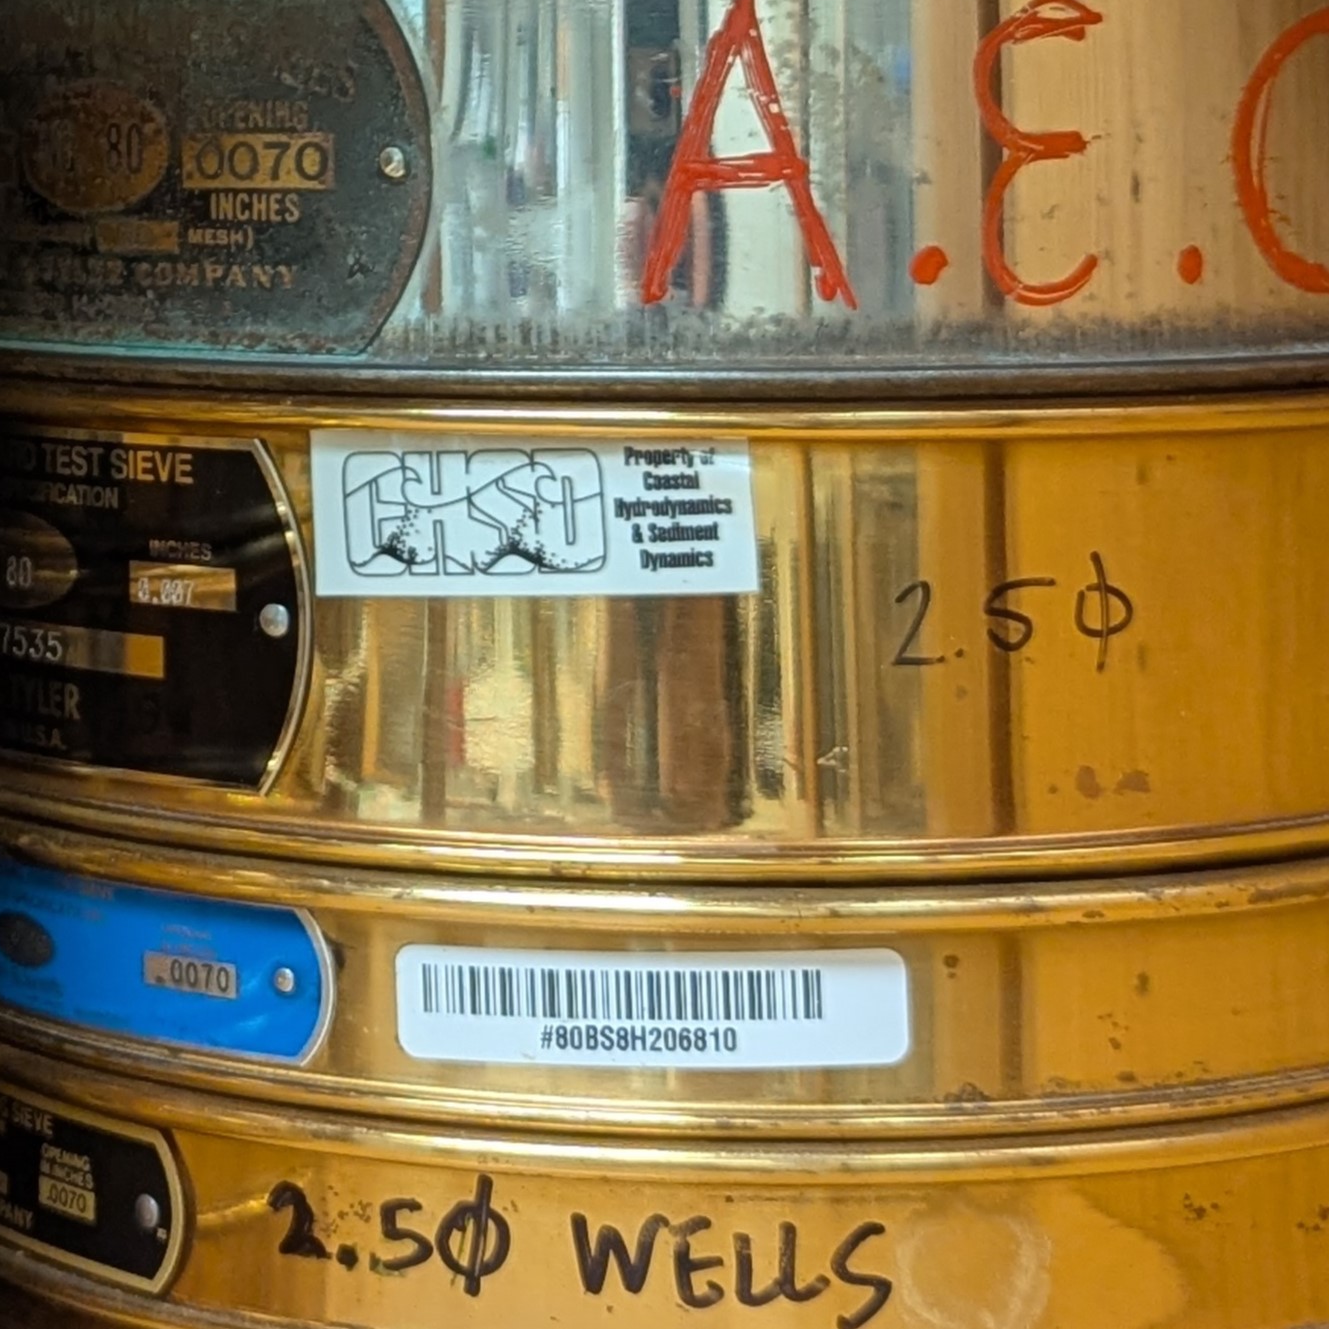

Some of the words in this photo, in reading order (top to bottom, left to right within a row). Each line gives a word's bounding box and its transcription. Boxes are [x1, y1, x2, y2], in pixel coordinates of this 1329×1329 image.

[105, 122, 144, 173] 80
[209, 191, 301, 224] INCHES
[133, 262, 298, 290] COMPANY
[41, 444, 104, 480] TEST
[110, 448, 195, 485] SIEVE
[623, 445, 695, 469] Property
[642, 470, 701, 492] Coastal
[613, 494, 734, 522] Hydrodynamics
[631, 522, 645, 544] &
[647, 520, 721, 544] Sediment
[639, 547, 715, 573] Dynamics
[539, 1024, 738, 1053] #80BS8H206810
